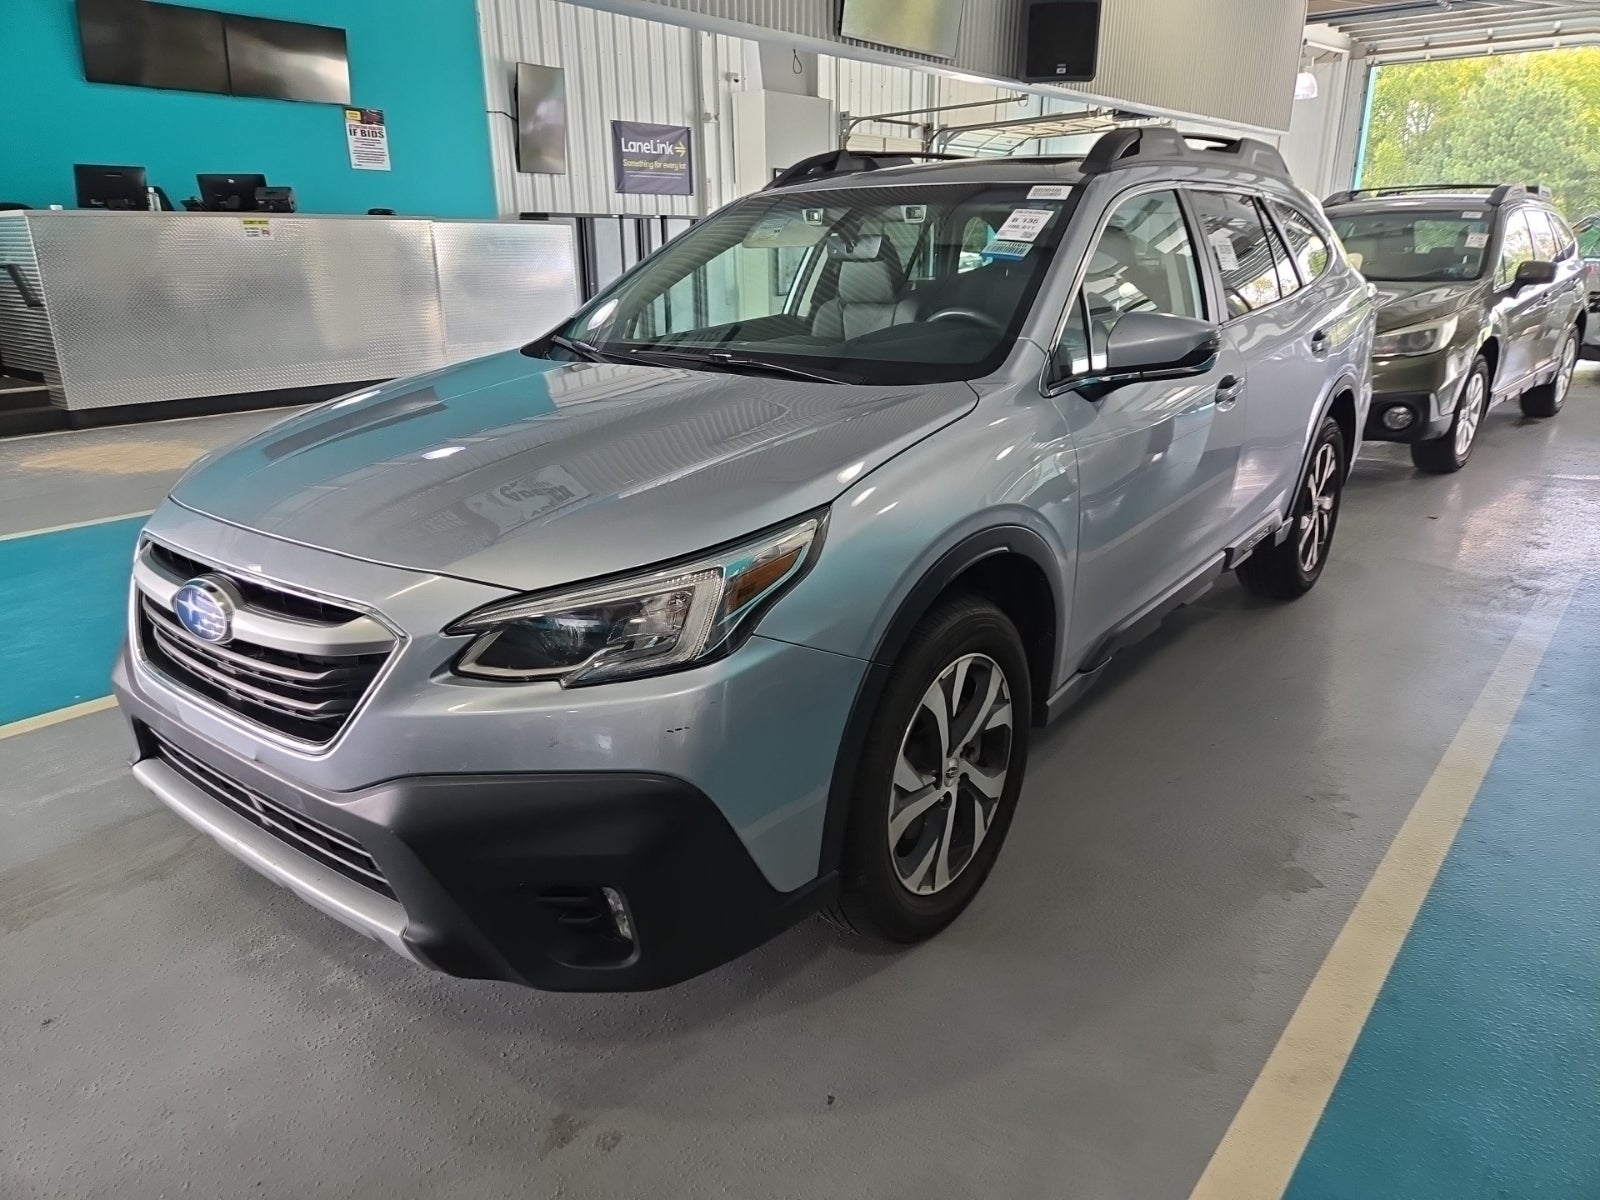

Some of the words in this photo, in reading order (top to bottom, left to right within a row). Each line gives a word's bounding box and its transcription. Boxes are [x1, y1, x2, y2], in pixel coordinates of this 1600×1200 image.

[349, 128, 358, 137] IF
[360, 129, 385, 139] BIDS
[621, 137, 674, 155] LaneLink
[622, 159, 654, 170] Something
[654, 160, 662, 168] for
[663, 162, 679, 171] every
